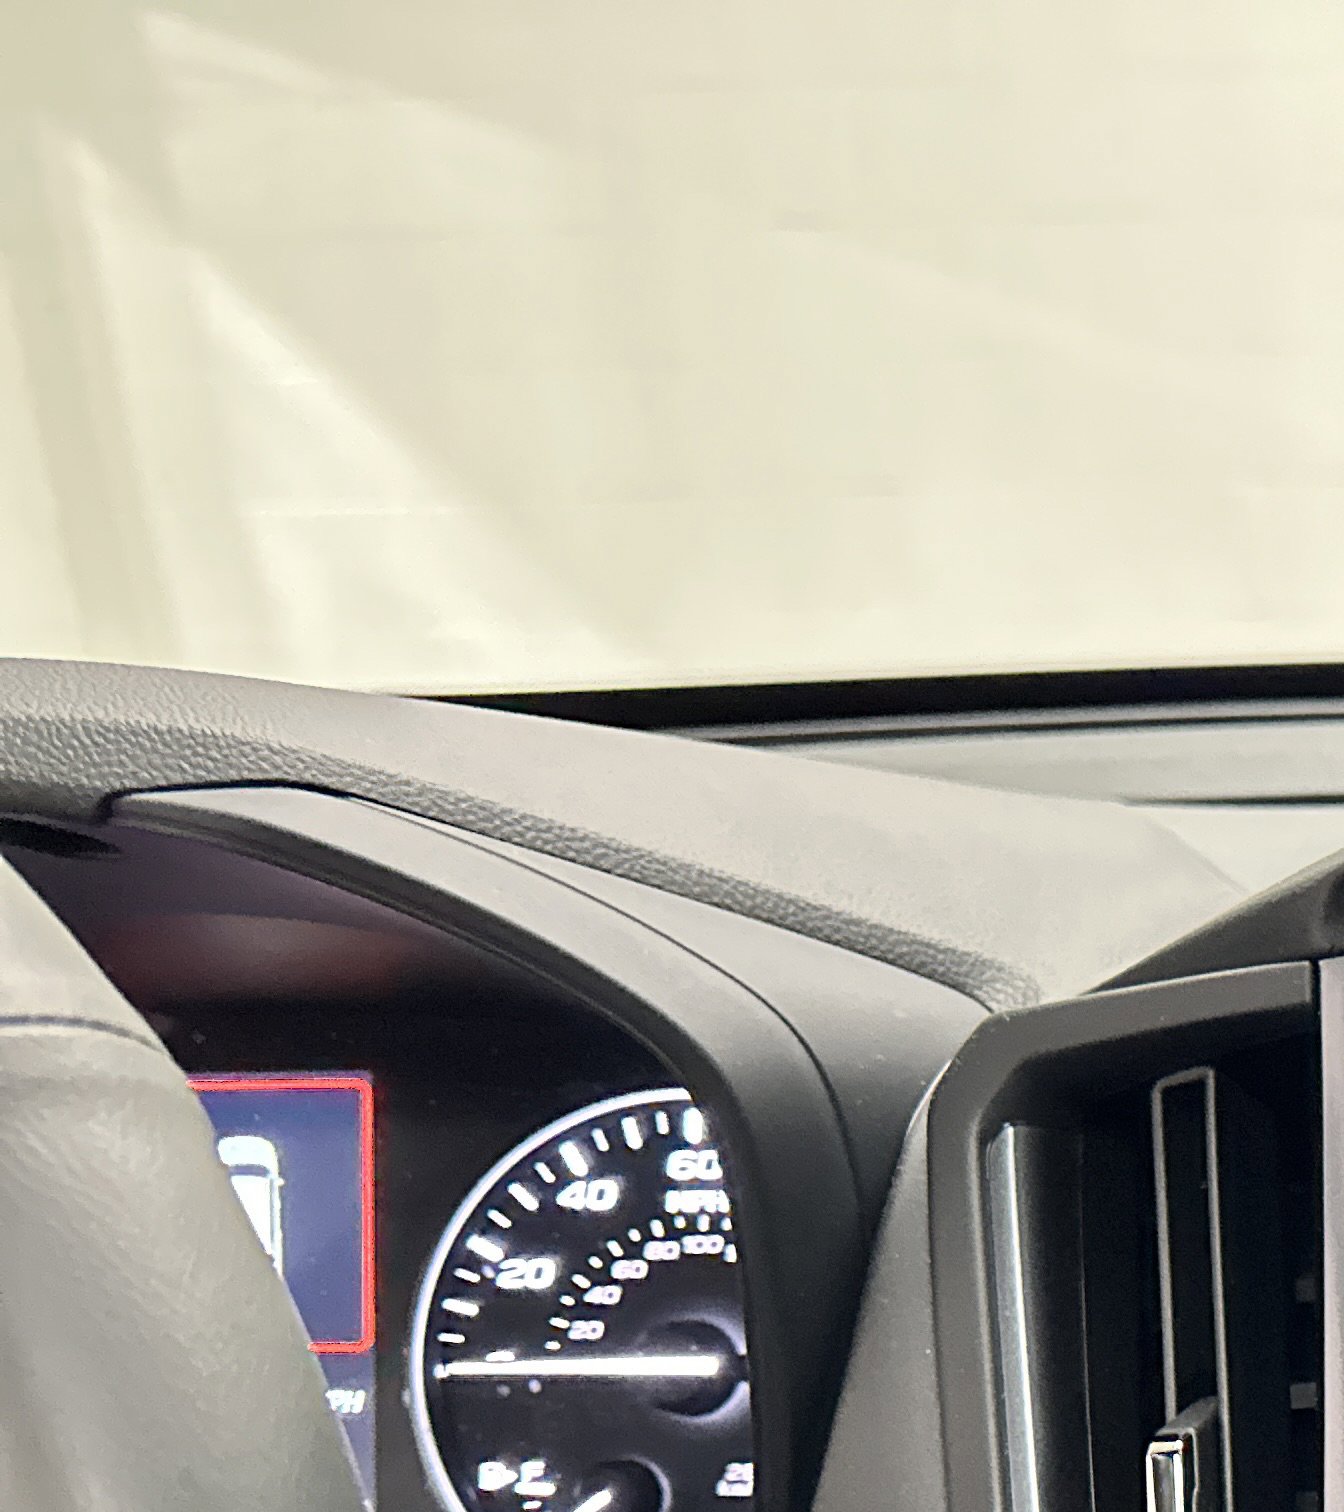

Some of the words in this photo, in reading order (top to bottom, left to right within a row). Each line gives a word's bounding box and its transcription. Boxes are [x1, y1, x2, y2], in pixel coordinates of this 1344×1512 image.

[666, 1150, 723, 1181] 60
[555, 1179, 620, 1212] 40
[495, 1257, 558, 1290] 20
[582, 1285, 624, 1306] 40
[567, 1320, 606, 1341] 20
